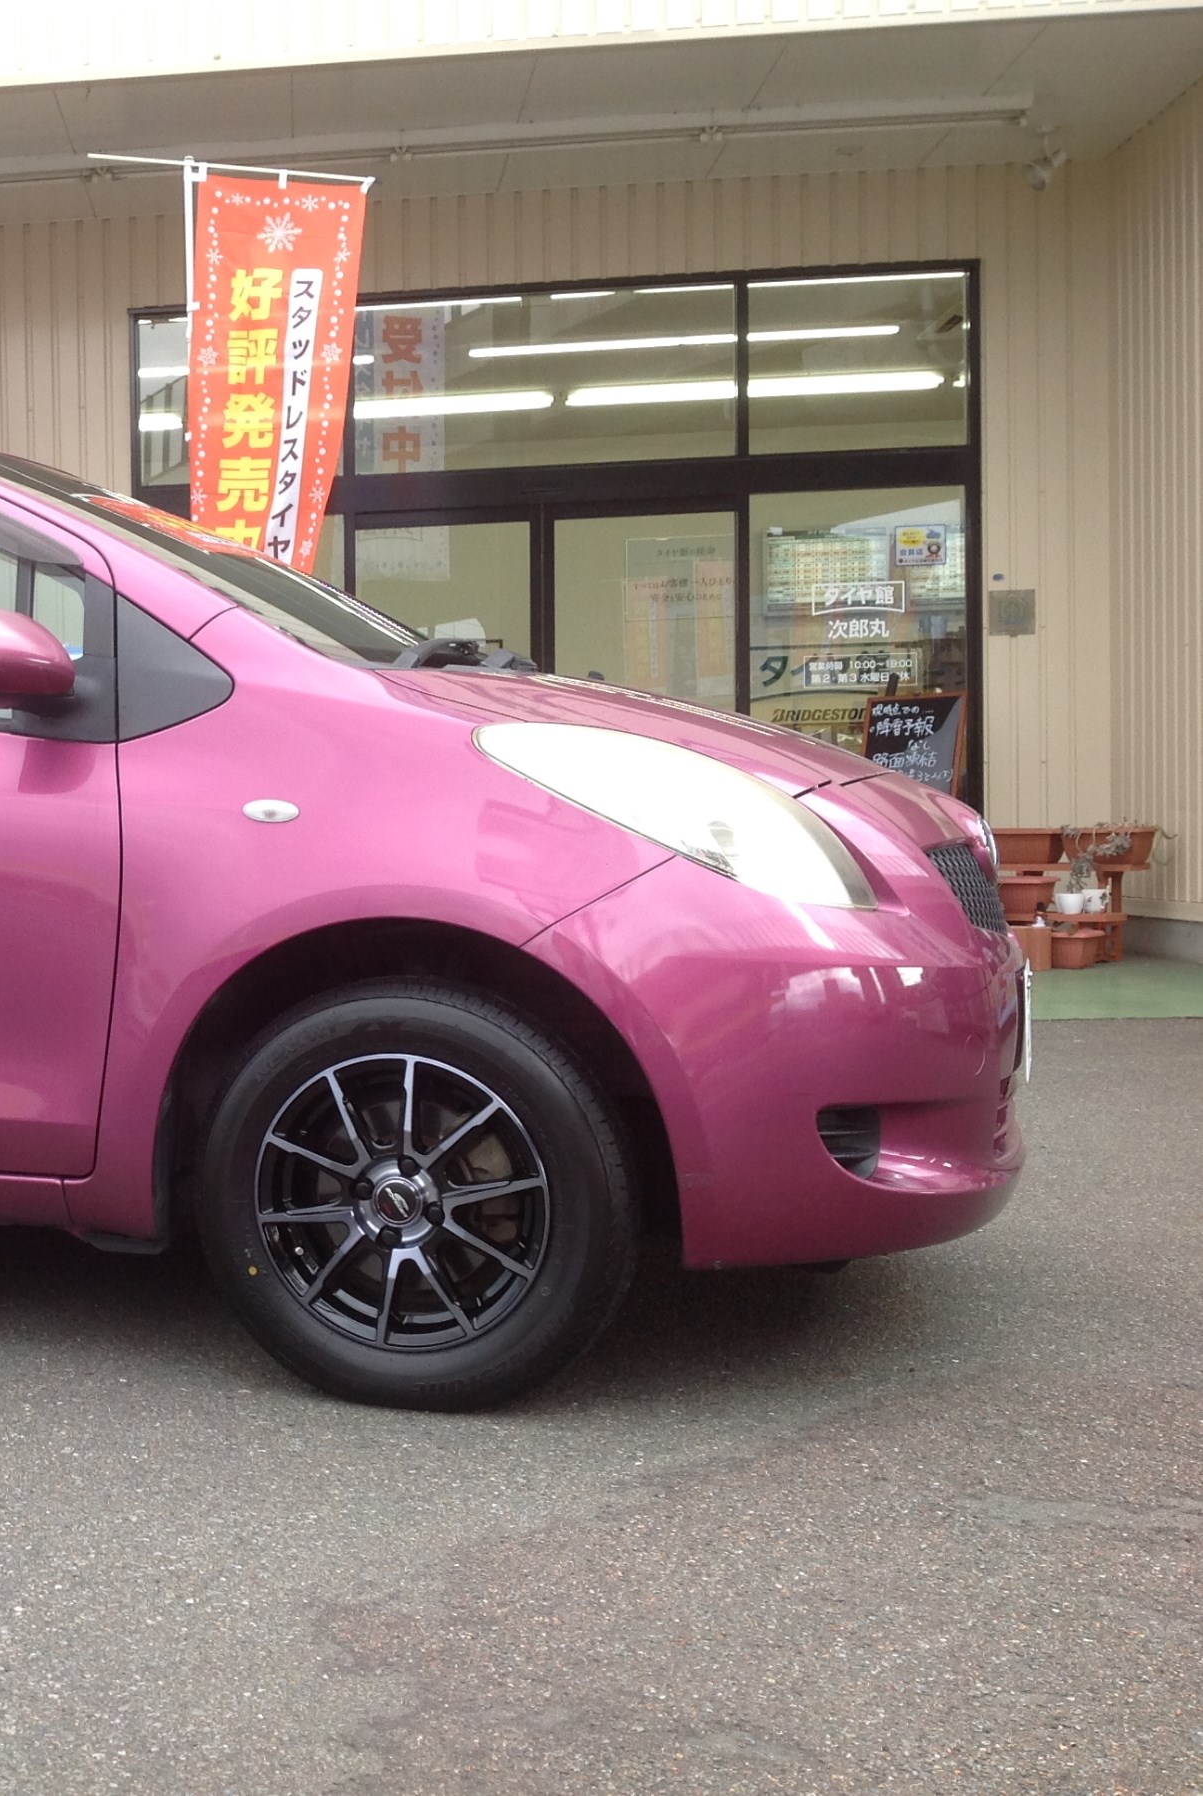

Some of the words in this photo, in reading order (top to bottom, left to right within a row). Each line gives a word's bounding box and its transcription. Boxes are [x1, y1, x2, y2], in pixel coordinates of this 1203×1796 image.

[268, 280, 314, 558] スタッドレスタイヤ
[825, 586, 894, 606] タイヤ館
[828, 618, 889, 639] 次郎丸
[809, 660, 843, 671] 営業時間
